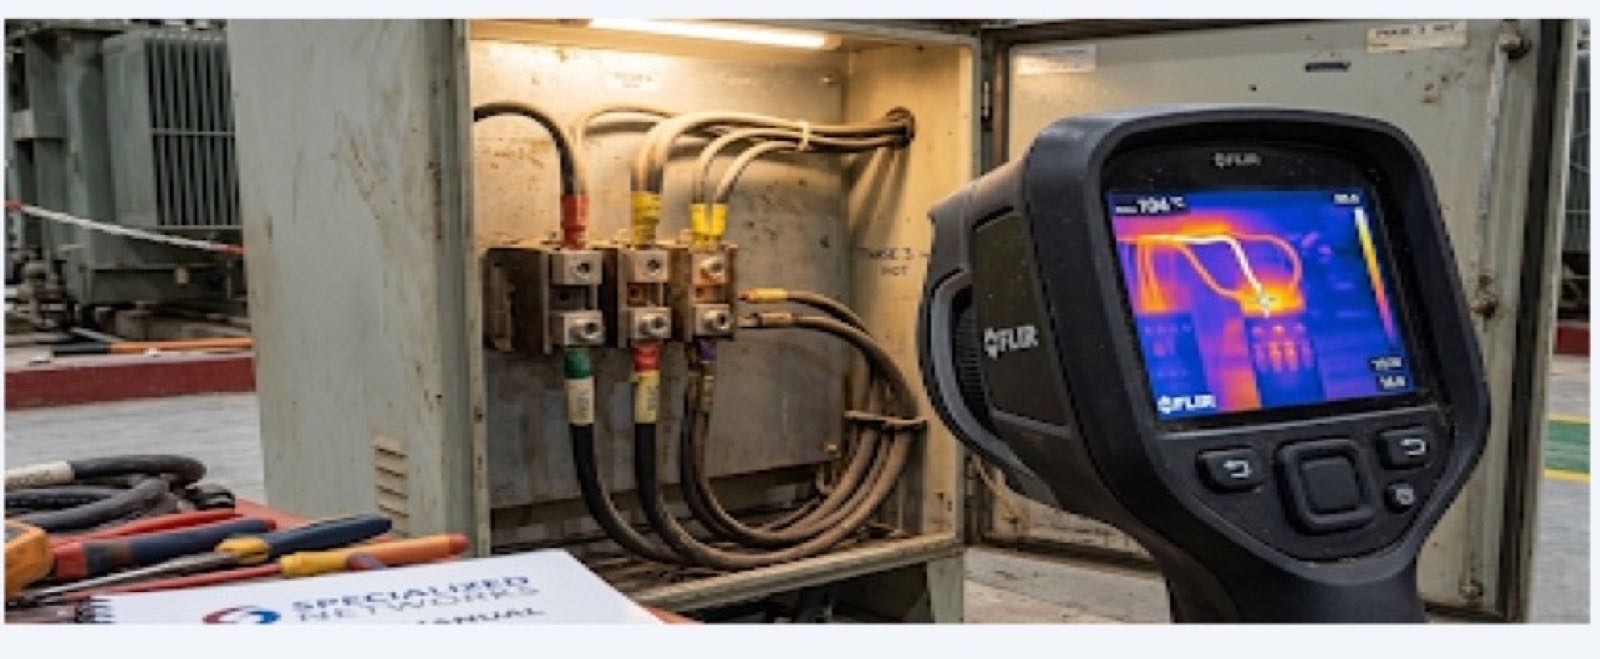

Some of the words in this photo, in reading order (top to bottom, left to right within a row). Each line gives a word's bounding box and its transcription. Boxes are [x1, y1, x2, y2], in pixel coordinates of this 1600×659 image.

[1225, 152, 1262, 166] FLIR
[997, 325, 1039, 352] FLIR
[1173, 394, 1217, 411] FLIR
[292, 576, 530, 611] SPECIALIZED
[298, 587, 541, 622] NETWORKS
